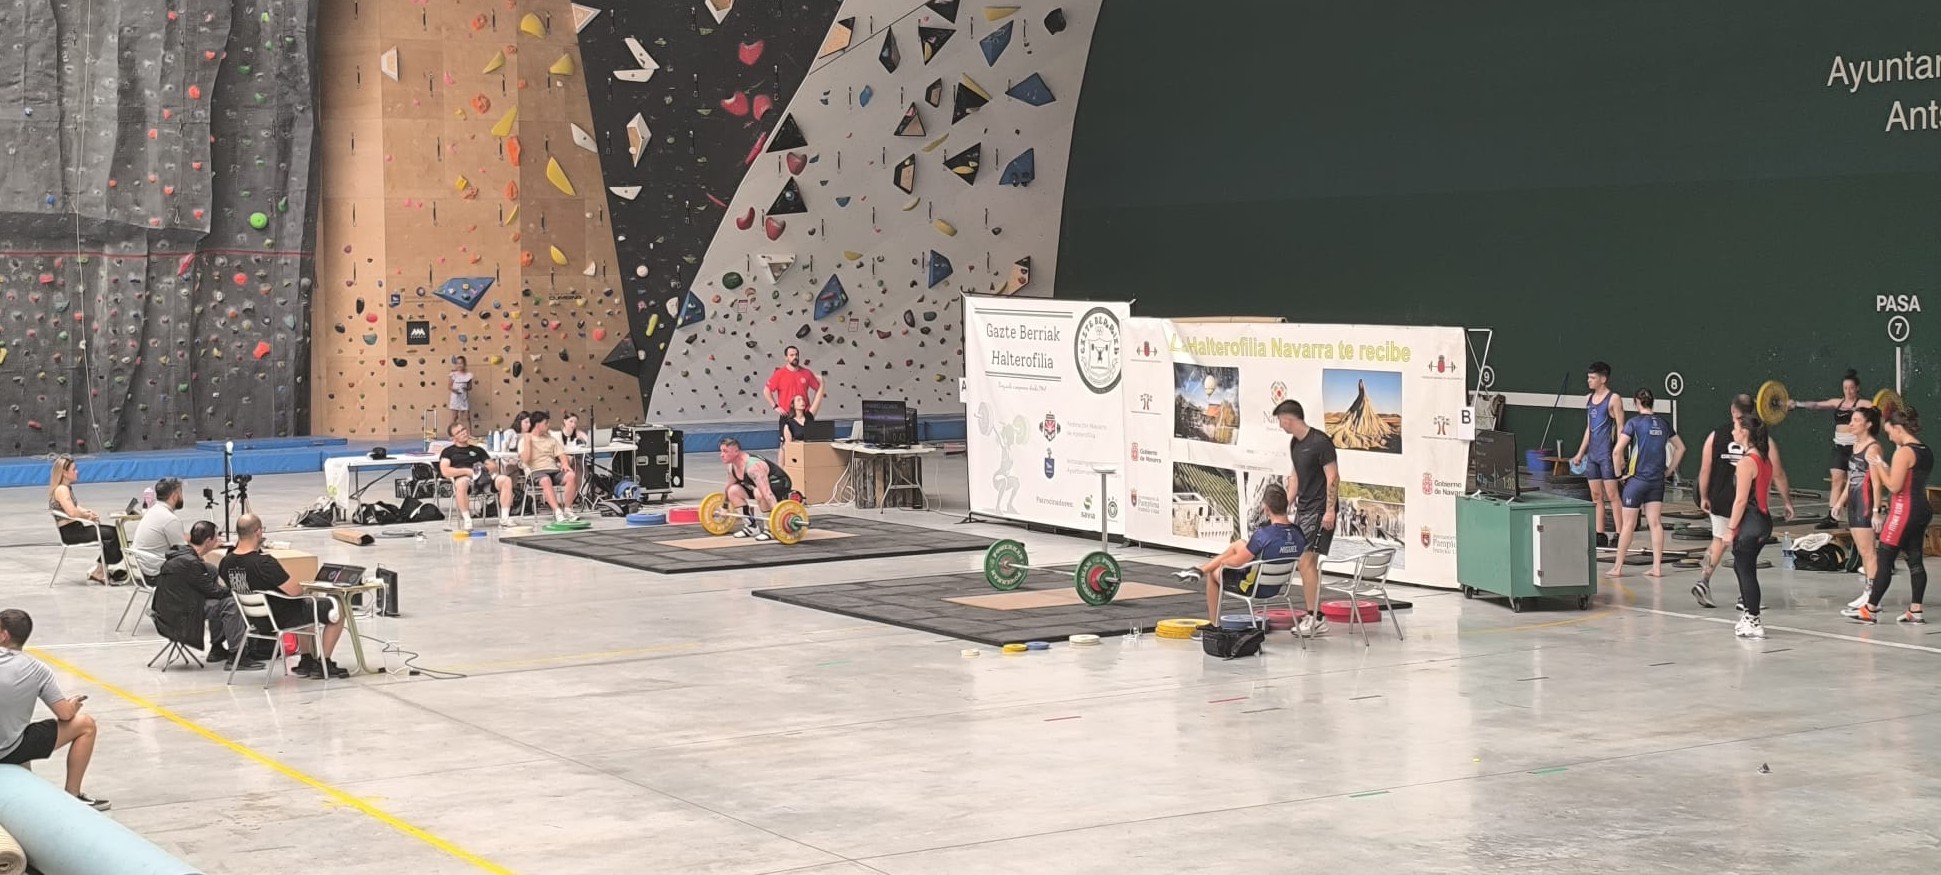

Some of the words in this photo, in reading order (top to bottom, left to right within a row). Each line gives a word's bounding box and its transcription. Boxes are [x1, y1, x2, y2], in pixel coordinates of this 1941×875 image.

[1885, 100, 1941, 131] Ant
[1876, 294, 1921, 312] PASA
[986, 322, 1016, 339] Gazte
[1019, 324, 1060, 342] Berriak
[1894, 322, 1903, 335] 7
[1186, 336, 1267, 357] Halterofilia
[1271, 337, 1335, 359] Navarra
[1338, 340, 1355, 361] te
[1359, 340, 1412, 363] recibe
[991, 349, 1054, 369] Halterofilia
[1483, 371, 1490, 382] 9
[1670, 378, 1678, 390] 8
[1461, 409, 1472, 425] B
